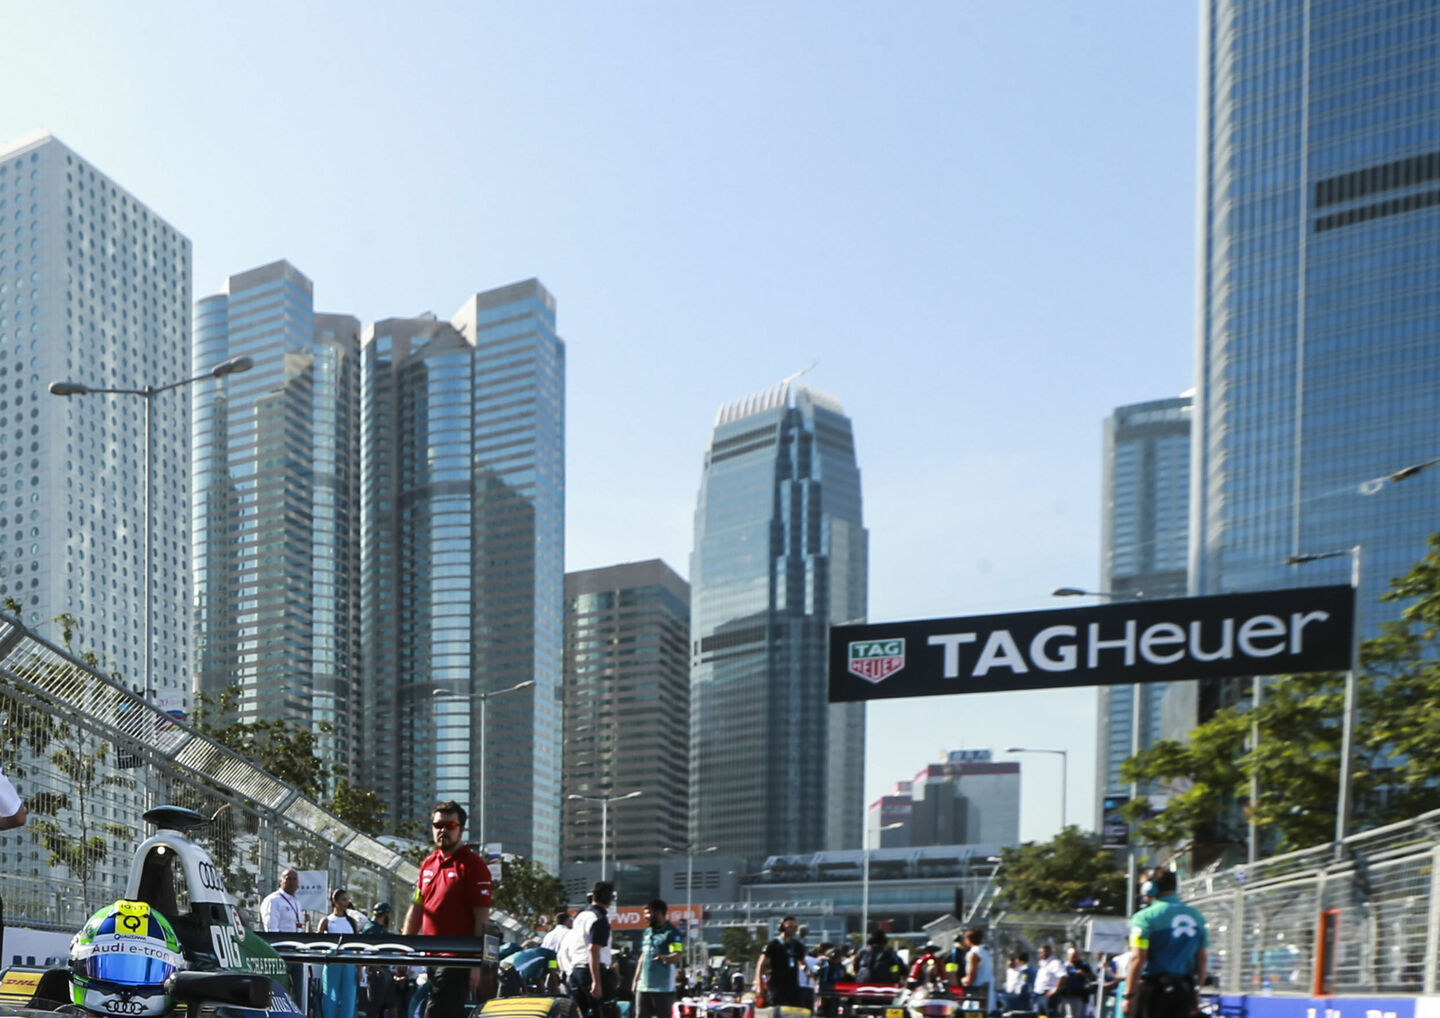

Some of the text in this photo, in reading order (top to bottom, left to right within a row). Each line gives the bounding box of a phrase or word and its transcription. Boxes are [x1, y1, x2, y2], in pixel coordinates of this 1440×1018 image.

[854, 642, 900, 657] TAG
[851, 657, 903, 679] HEUER
[92, 943, 170, 960] Audi e-tron
